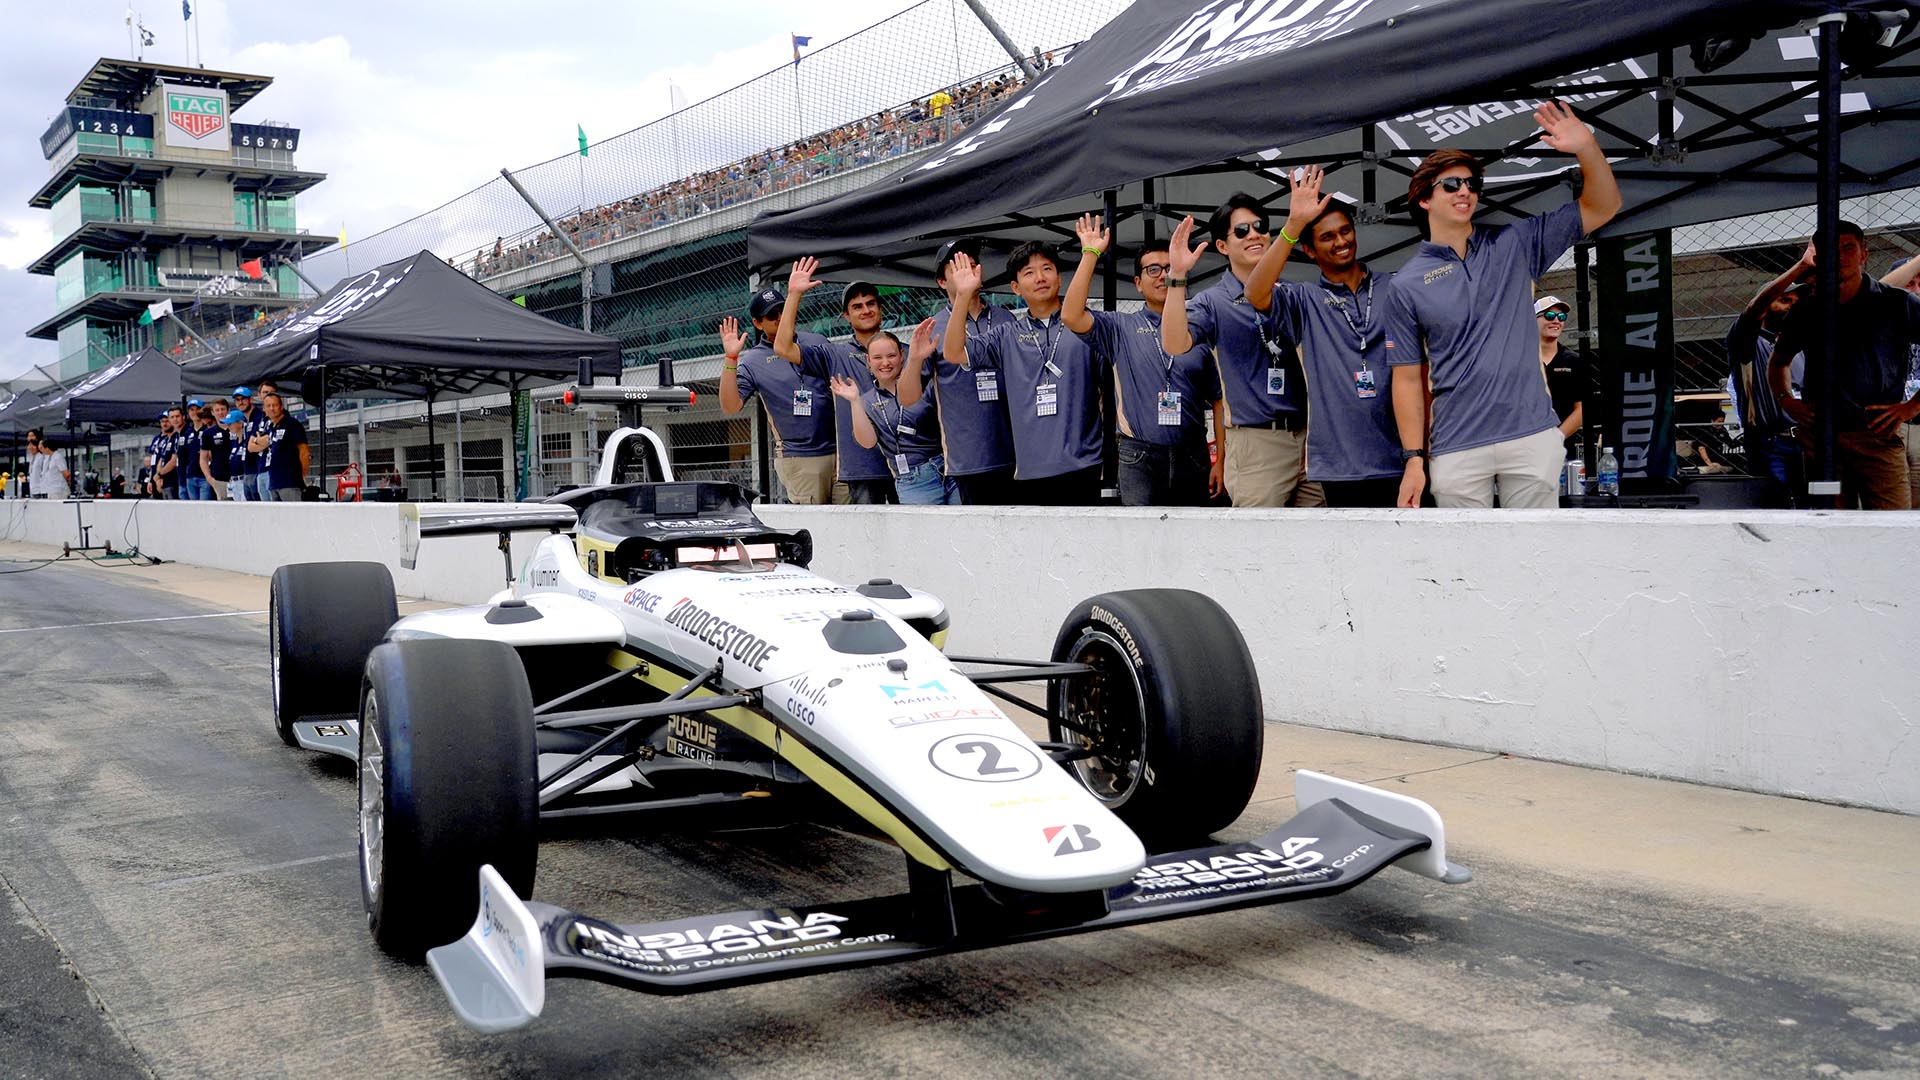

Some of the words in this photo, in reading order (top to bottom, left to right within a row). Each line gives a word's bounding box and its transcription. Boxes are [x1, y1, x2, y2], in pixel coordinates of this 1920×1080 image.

[173, 96, 217, 113] TAG
[78, 120, 85, 131] 1
[94, 122, 102, 132] 2
[110, 123, 118, 133] 3
[126, 125, 134, 135] 4
[172, 113, 220, 136] HEUER
[242, 136, 250, 146] 5
[257, 137, 265, 147] 6
[271, 139, 279, 148] 7
[286, 140, 293, 149] 8
[1624, 233, 1660, 292] RA
[1625, 311, 1659, 349] AI
[624, 392, 648, 400] CISCO
[1621, 369, 1656, 478] RDUE
[624, 588, 662, 613] dSPACE
[664, 597, 779, 672] BRIDGESTONE
[1091, 605, 1144, 668] BRIDGESTONE
[787, 697, 815, 726] CISCO
[668, 714, 718, 748] PURDUE
[677, 743, 713, 765] RACING
[955, 741, 1020, 775] 2
[1133, 886, 1221, 903] Economic
[1331, 843, 1375, 869] Corp.
[1135, 836, 1320, 879] NDIANA
[1183, 850, 1324, 884] BOLD
[574, 912, 849, 949] INDIANA
[666, 924, 841, 960] BOLD
[581, 948, 690, 972] Economic
[694, 941, 838, 967] Development
[840, 933, 896, 947] Corp.
